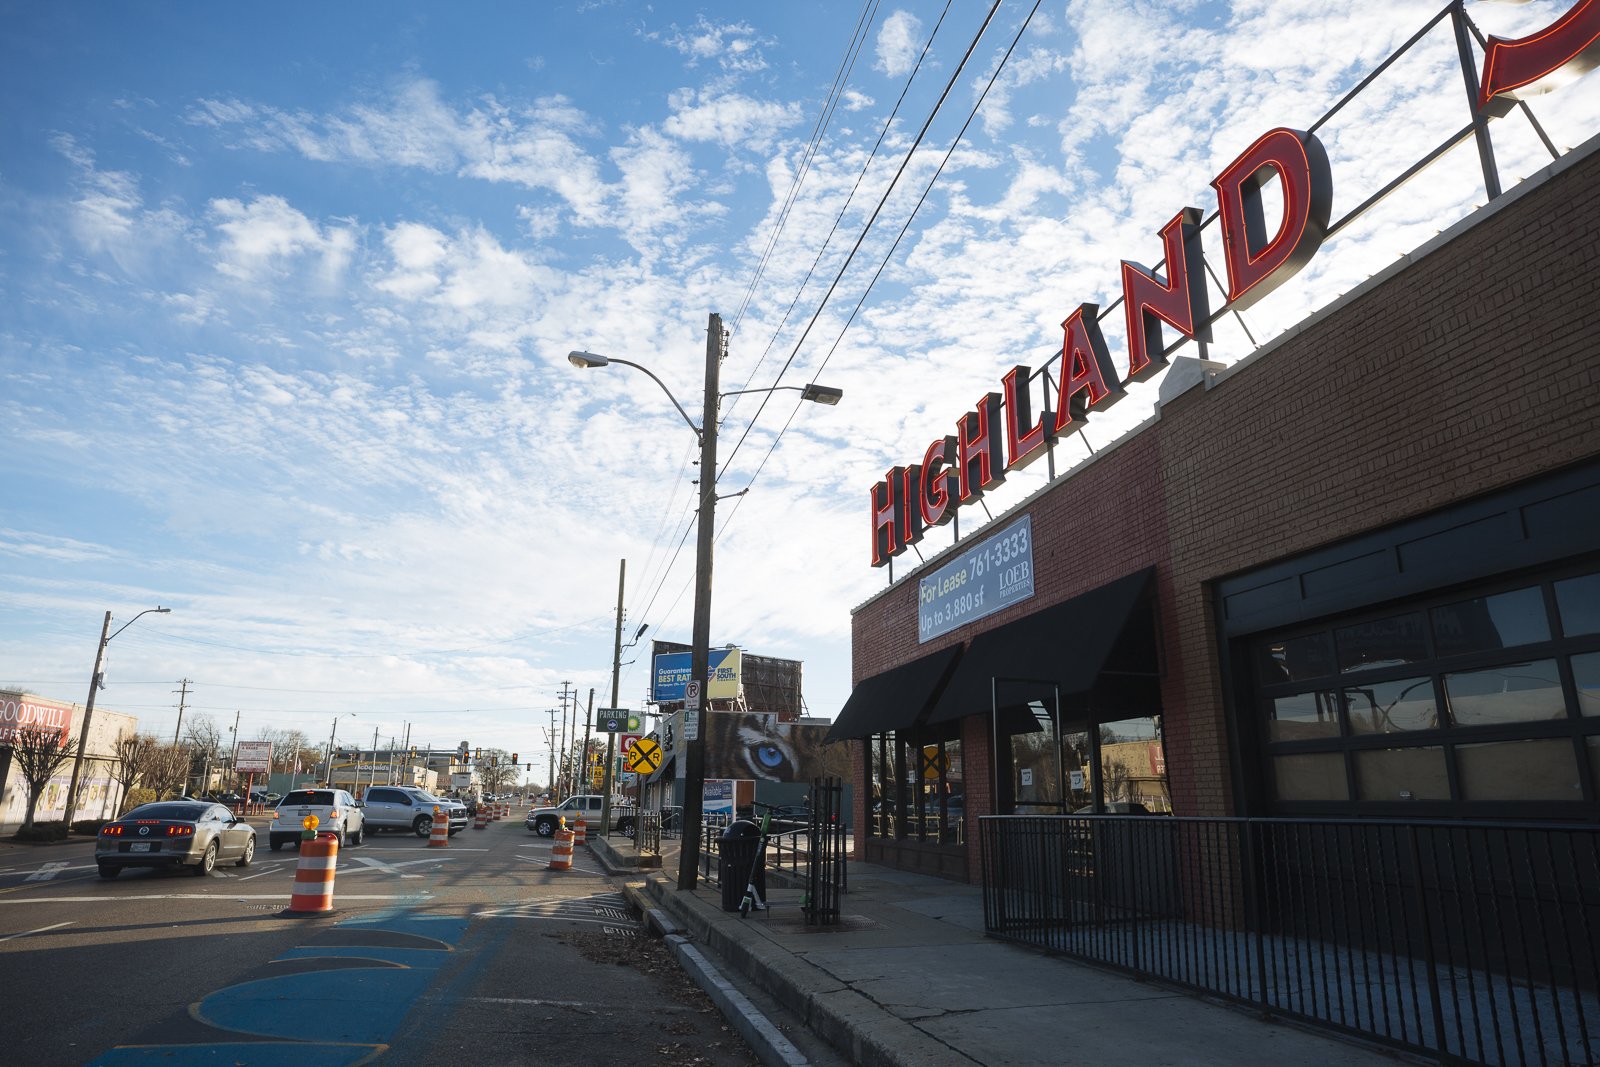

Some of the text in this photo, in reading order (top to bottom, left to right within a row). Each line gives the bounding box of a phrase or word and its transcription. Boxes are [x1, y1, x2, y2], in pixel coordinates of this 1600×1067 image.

[871, 127, 1332, 567] HIGHLAND
[920, 528, 1028, 607] For Lease 761-3333
[999, 561, 1029, 590] LOEB
[999, 579, 1030, 599] PROPERTIES
[921, 584, 985, 635] Up to 3,880 sf
[658, 673, 691, 683] BEST RAT
[599, 710, 627, 719] PARKING
[630, 751, 660, 761] R R
